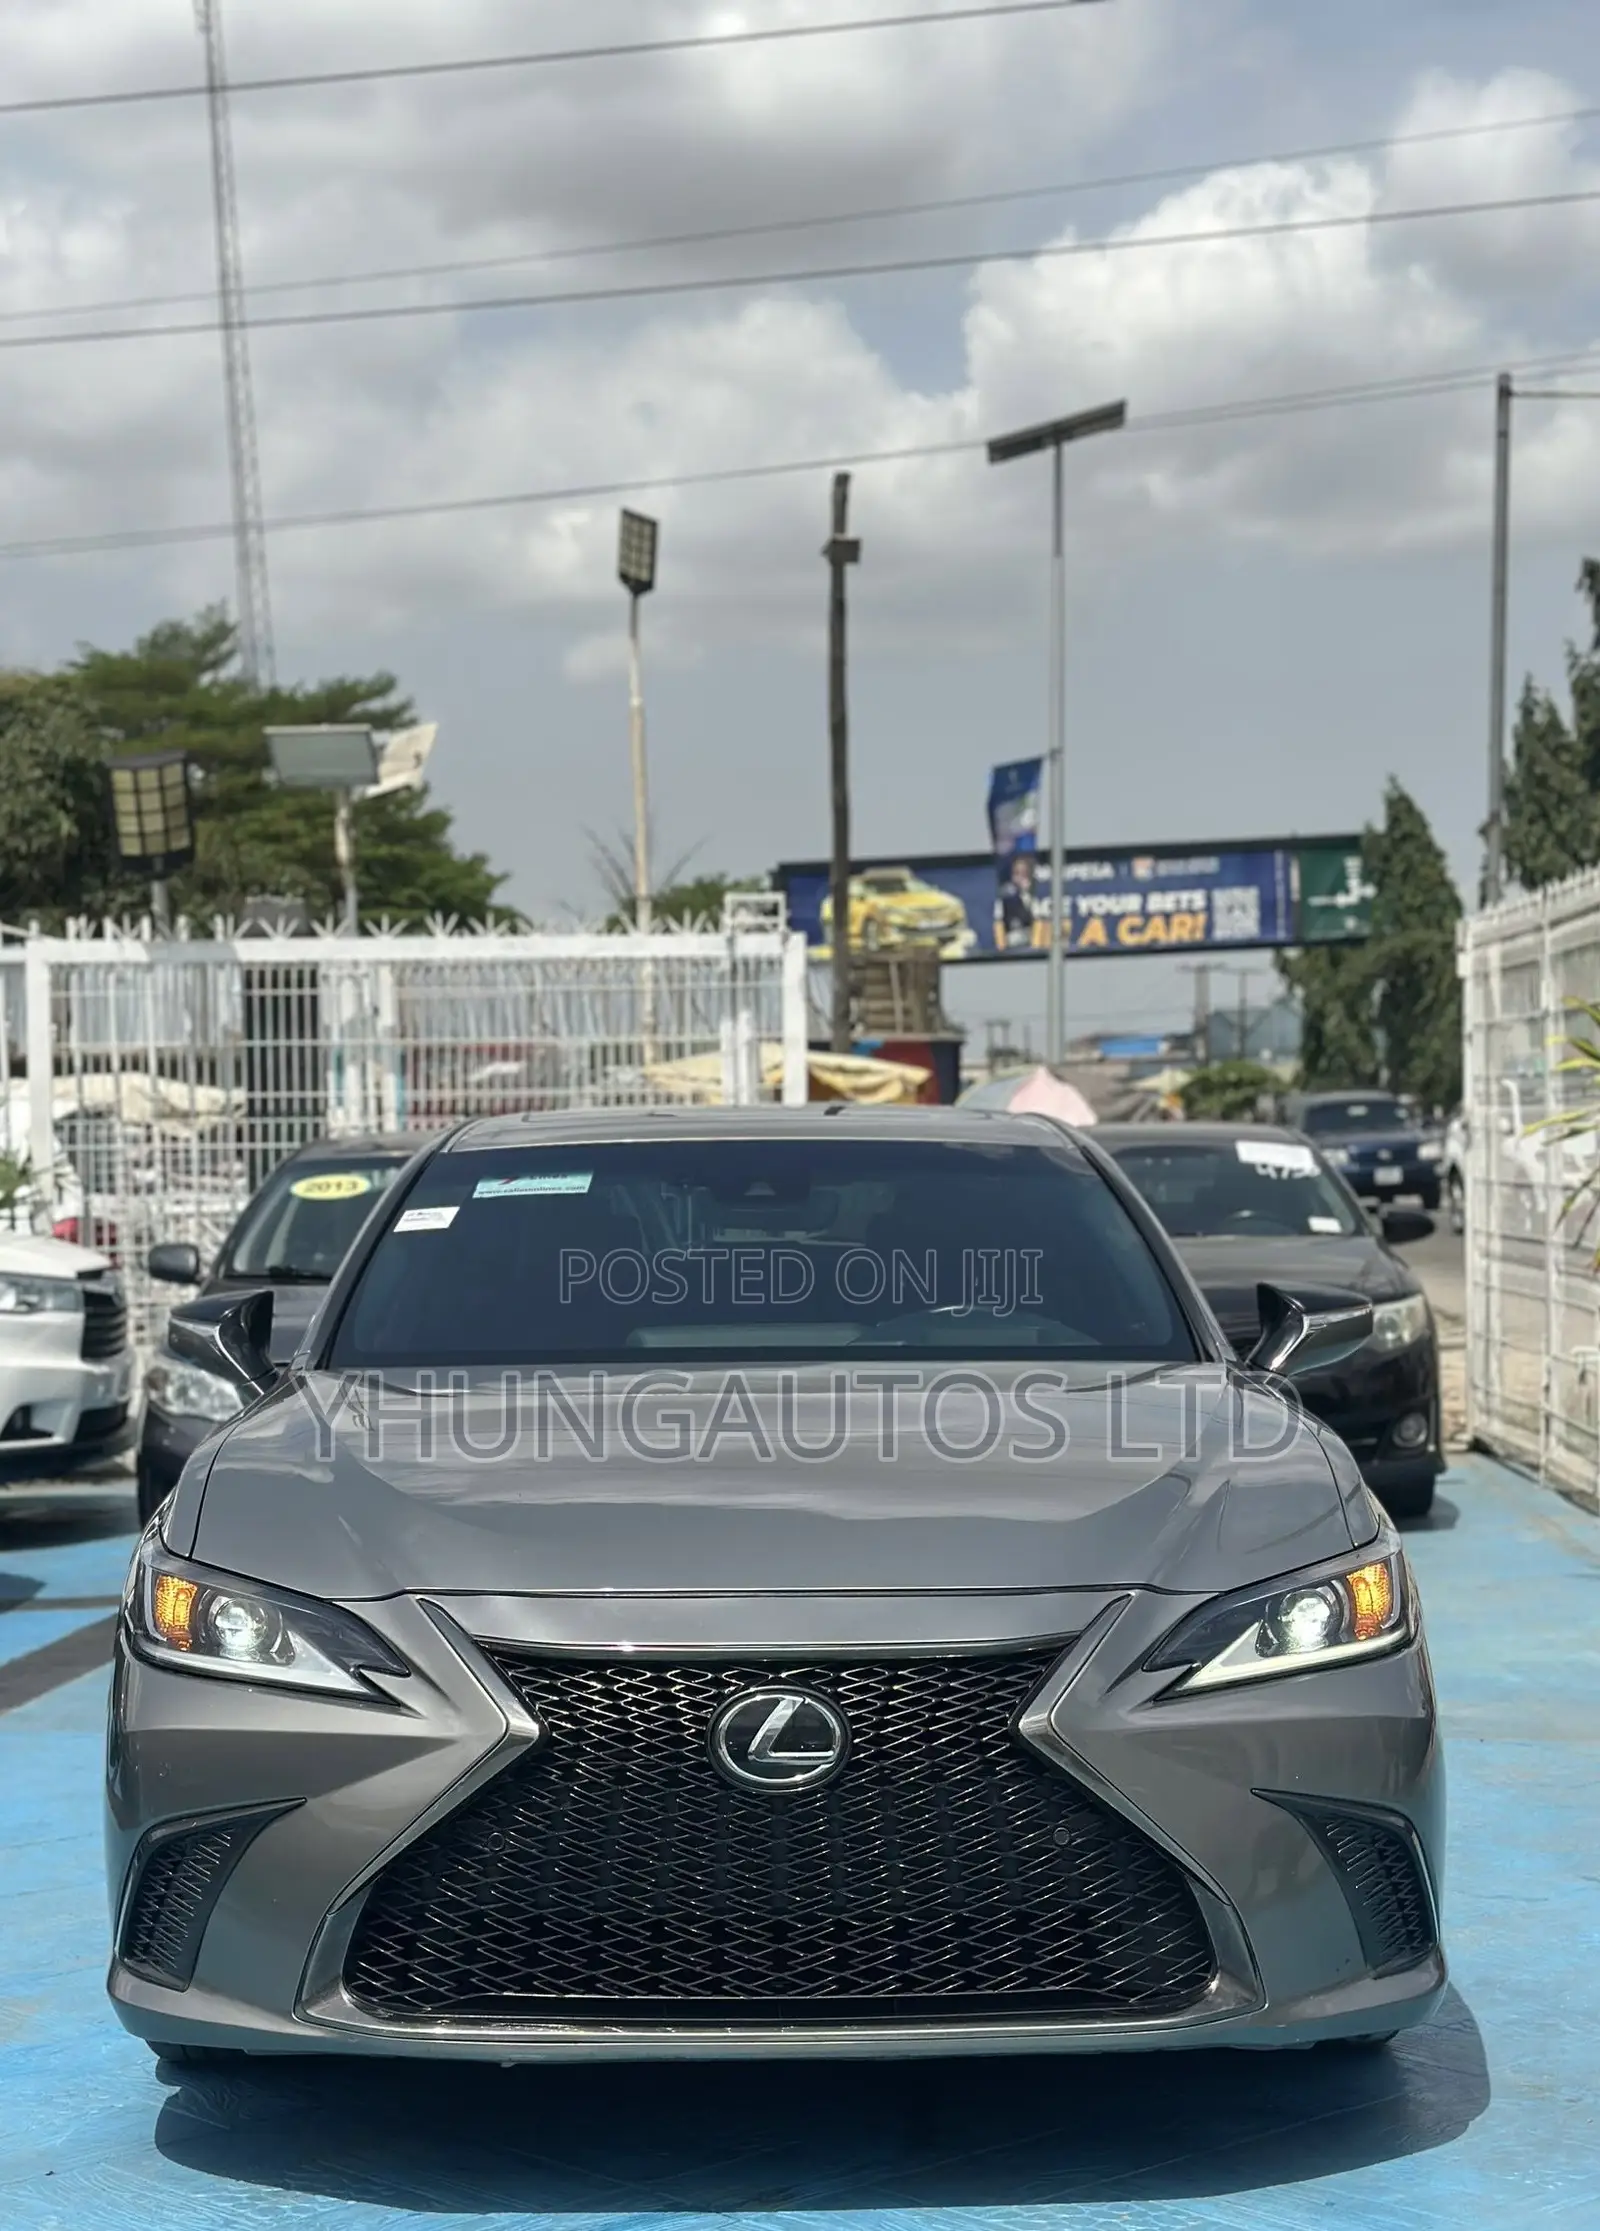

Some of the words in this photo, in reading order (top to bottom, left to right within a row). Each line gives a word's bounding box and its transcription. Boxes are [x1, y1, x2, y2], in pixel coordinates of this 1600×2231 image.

[1076, 892, 1144, 915] YOUR
[1146, 889, 1207, 911] BETS
[1079, 915, 1107, 946] A
[1117, 911, 1208, 945] CAR!
[303, 1180, 359, 1194] 2013
